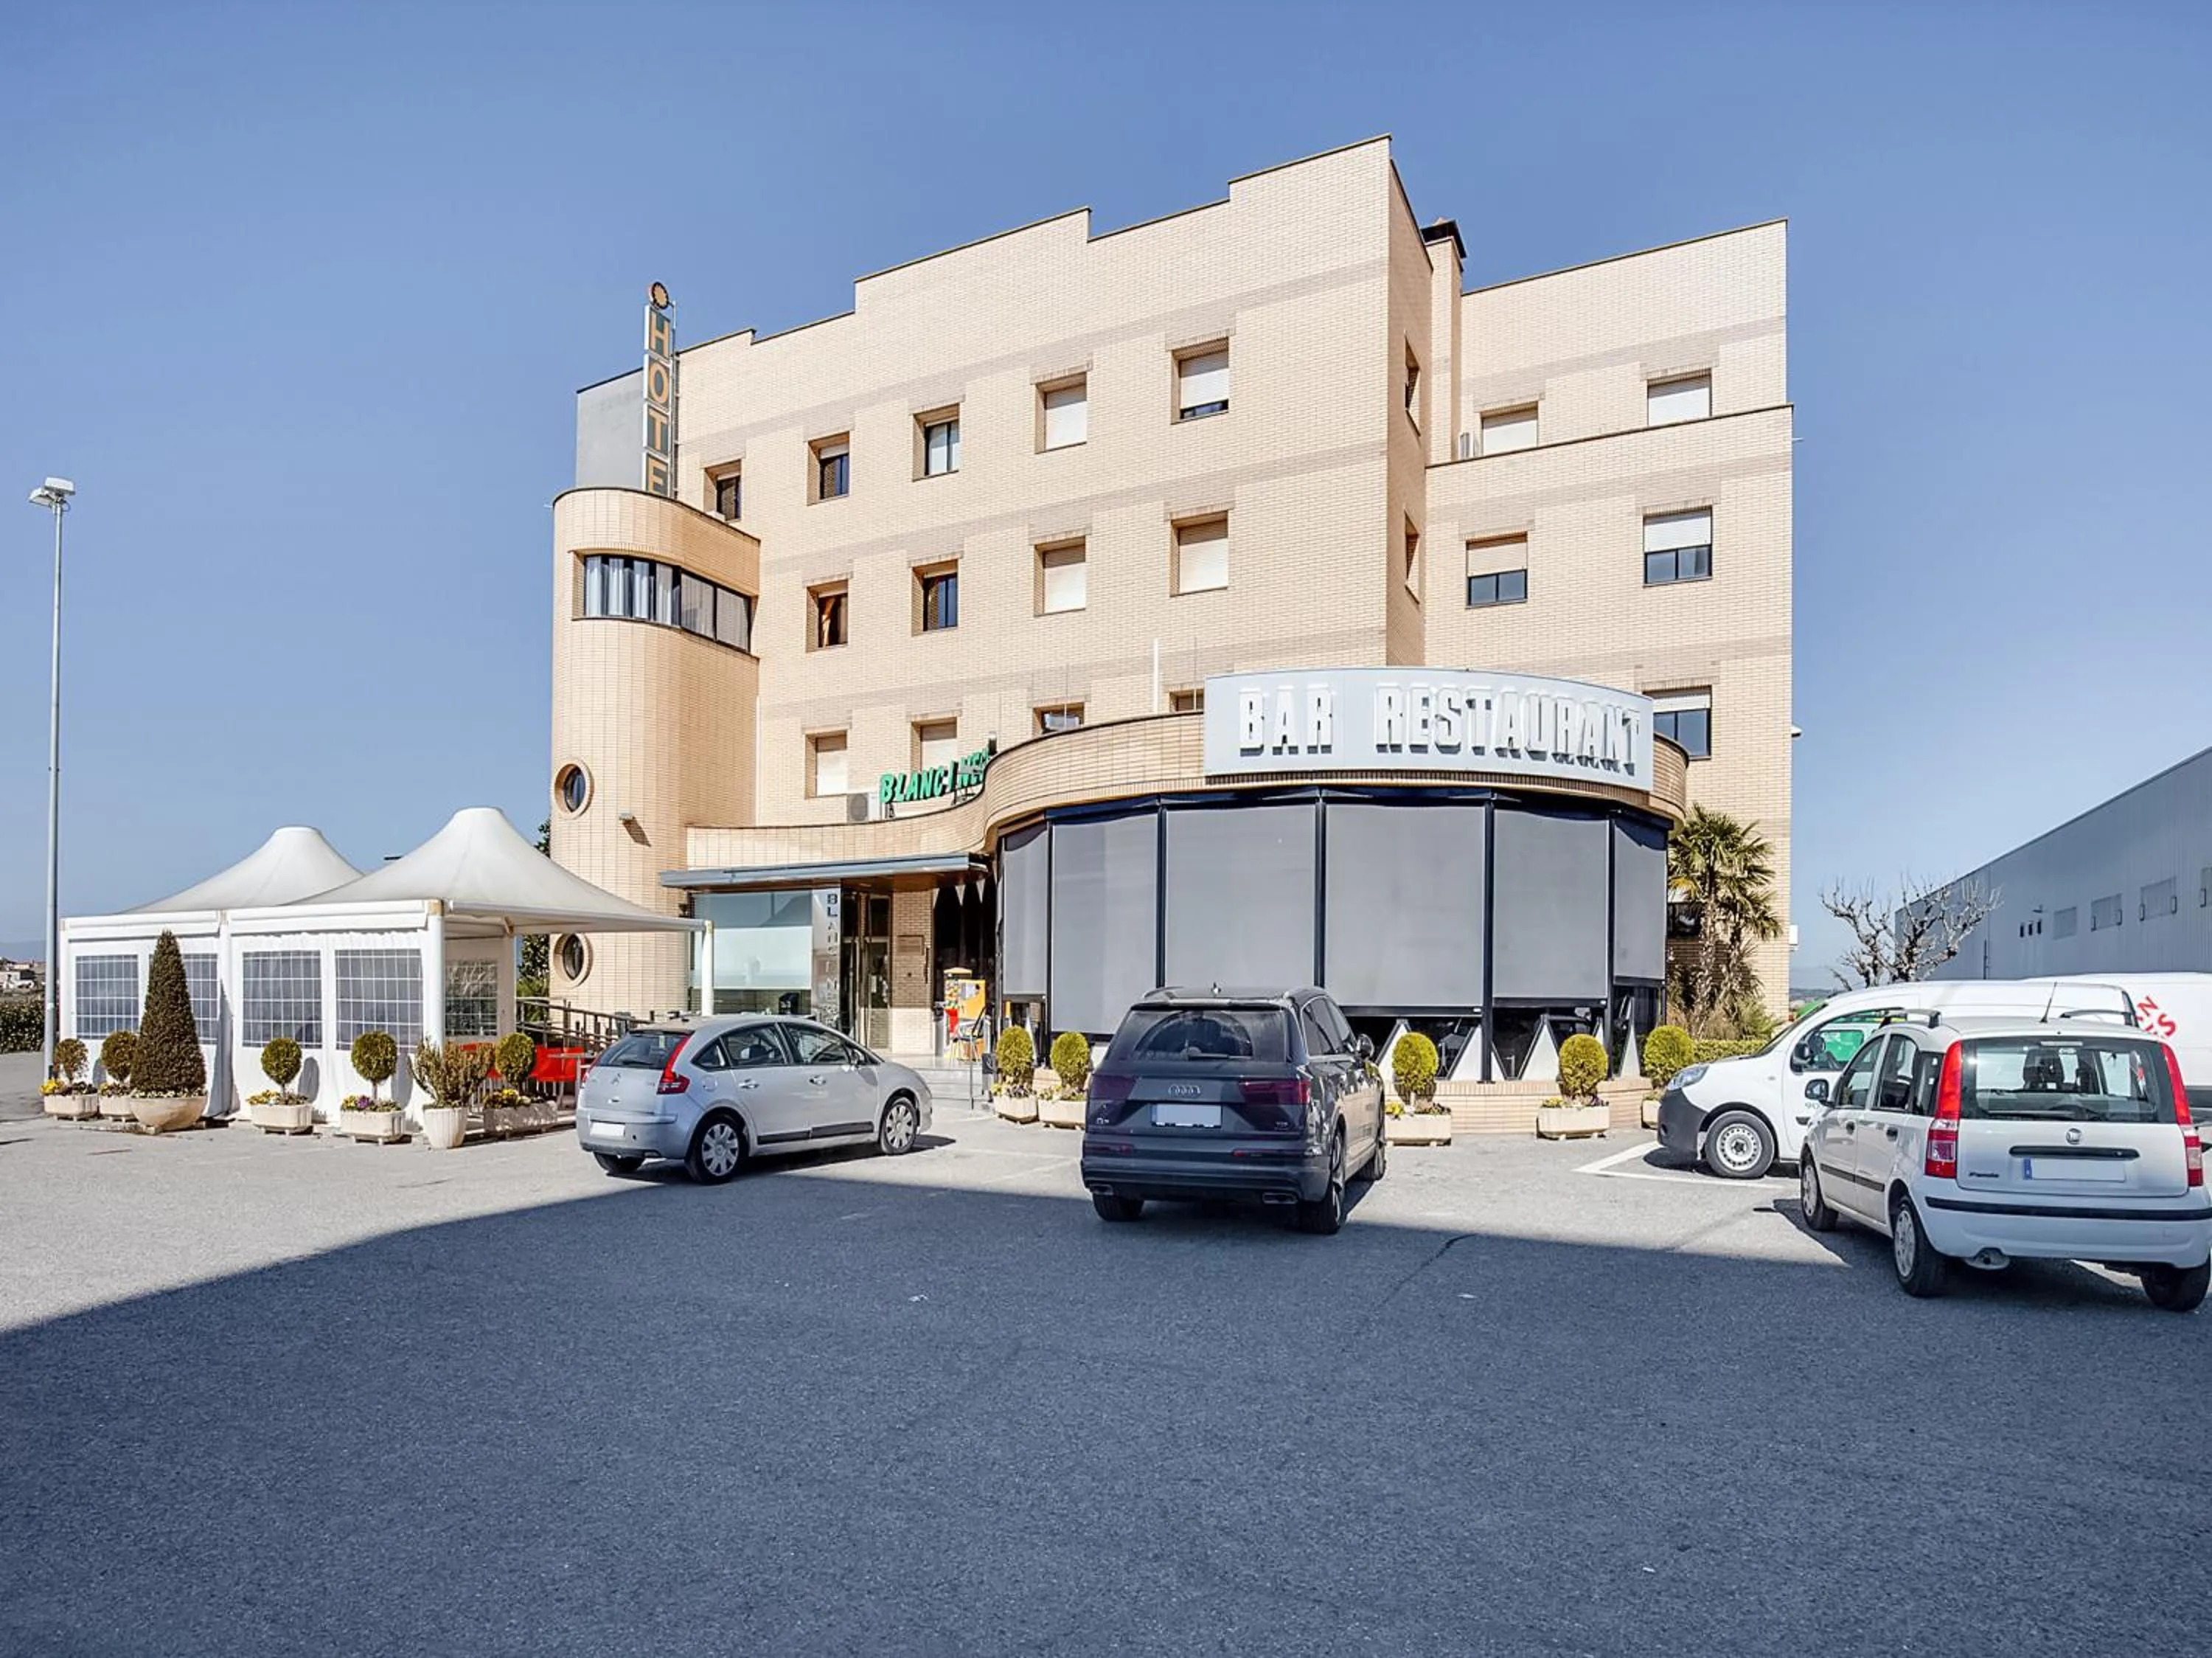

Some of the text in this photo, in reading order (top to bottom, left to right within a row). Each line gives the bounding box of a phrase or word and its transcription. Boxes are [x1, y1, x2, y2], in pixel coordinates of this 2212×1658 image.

[648, 308, 670, 496] HOTE
[1238, 684, 1640, 777] BAR RESTAURANT
[880, 766, 947, 804] BLANC
